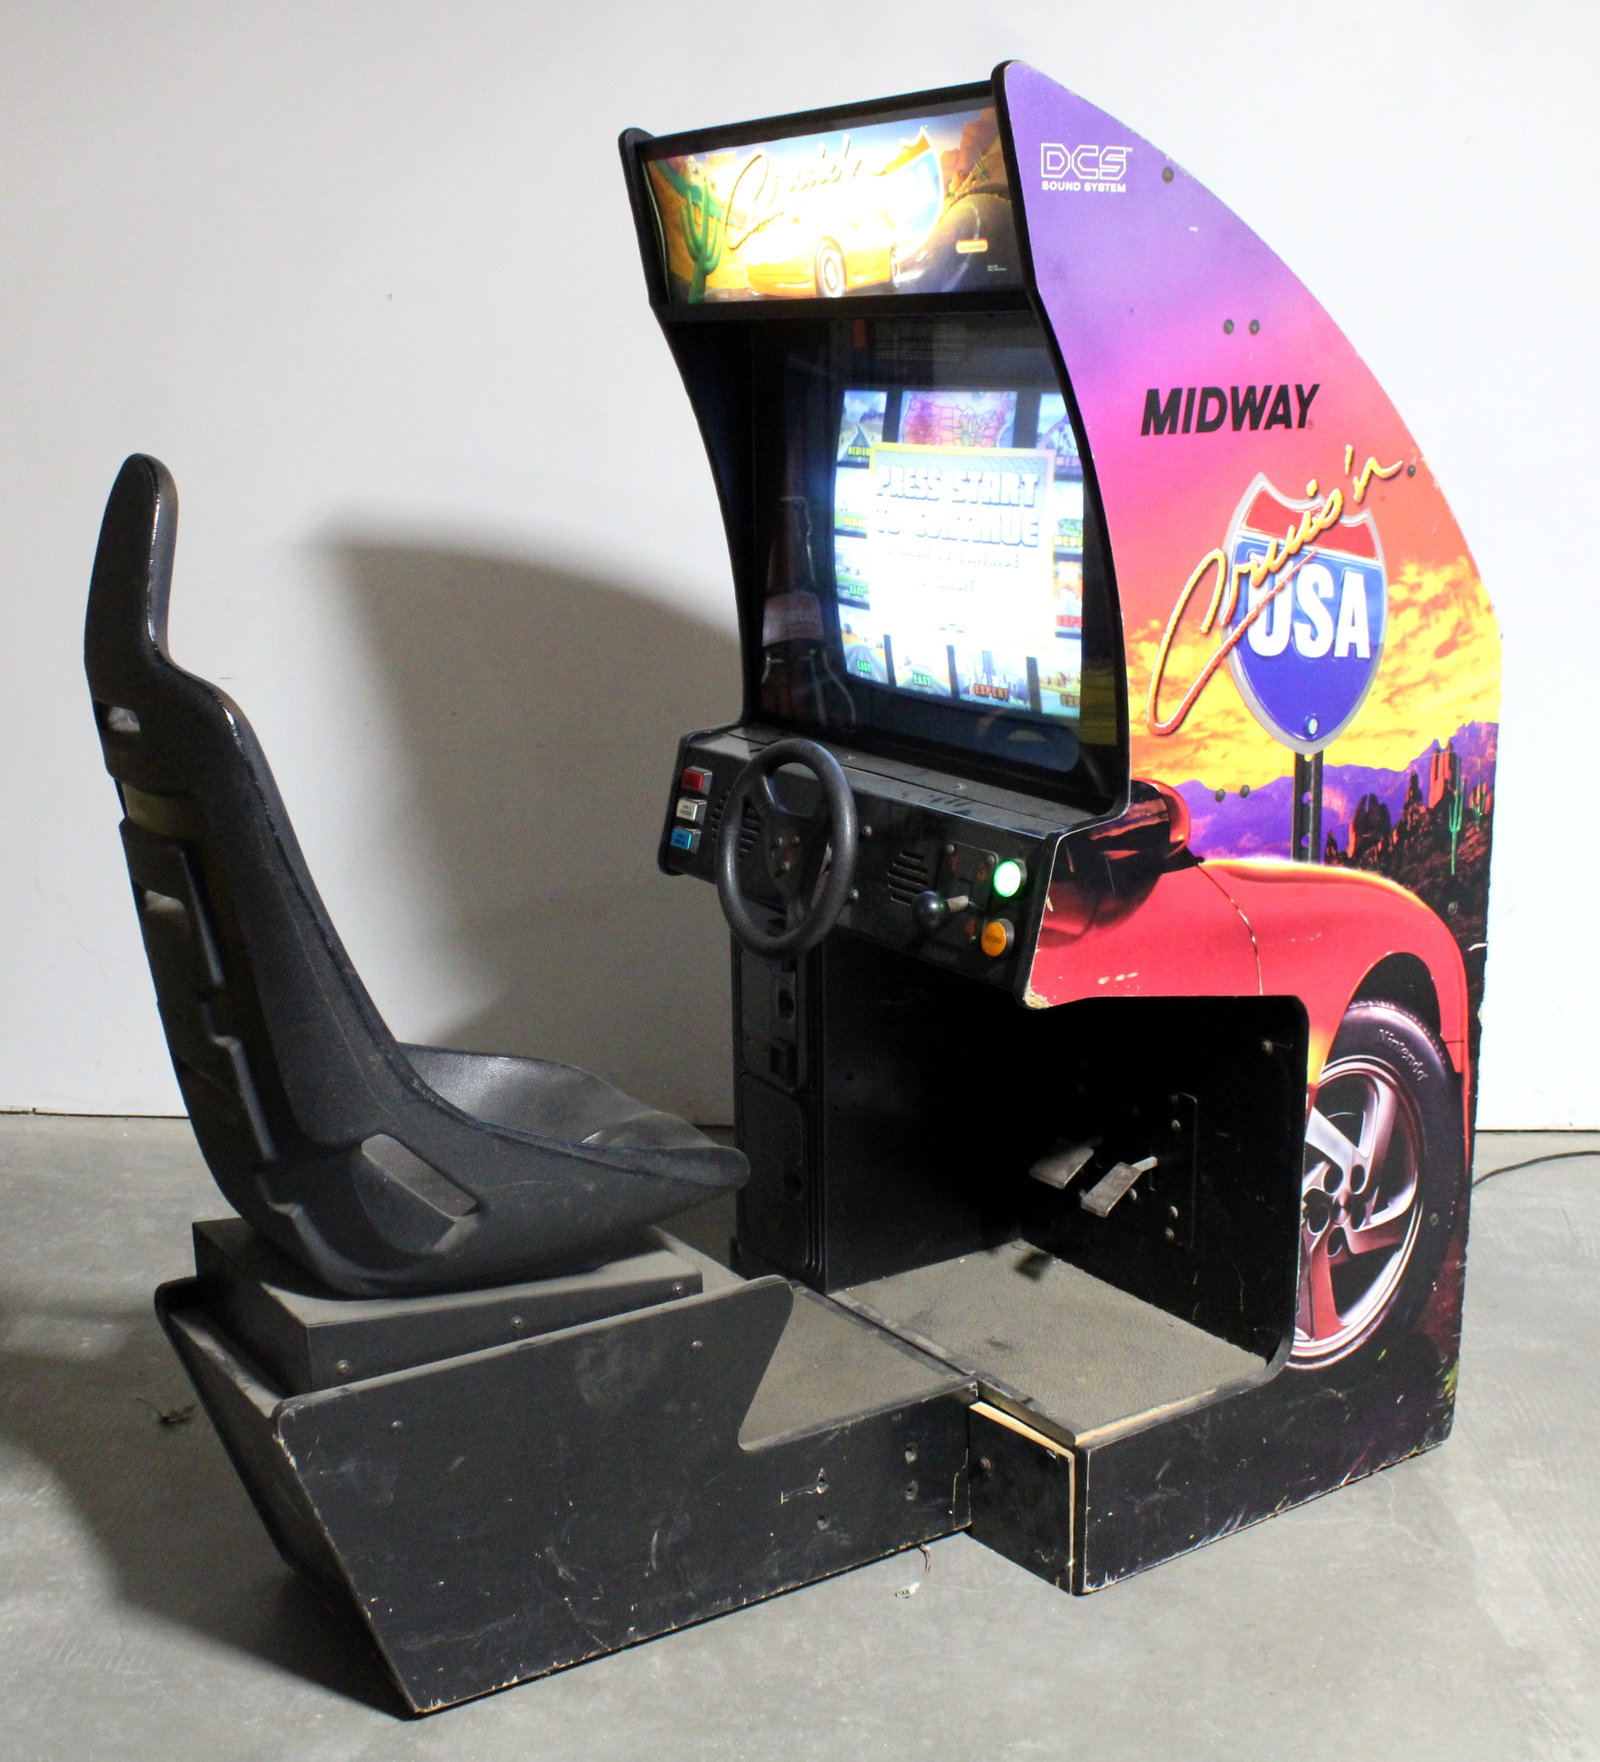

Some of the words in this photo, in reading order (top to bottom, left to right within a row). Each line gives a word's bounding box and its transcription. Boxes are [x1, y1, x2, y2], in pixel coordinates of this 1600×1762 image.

[1041, 143, 1127, 181] DCS
[1041, 180, 1081, 191] SOUND
[1083, 182, 1127, 193] SYSTEM
[1141, 384, 1320, 436] MIDWAY
[876, 465, 941, 501] PRESS
[950, 470, 1039, 508] START
[1246, 552, 1371, 659] USA
[913, 673, 932, 687] EASY
[973, 683, 1009, 699] EXPERT
[1379, 1029, 1429, 1082] Nintendo
